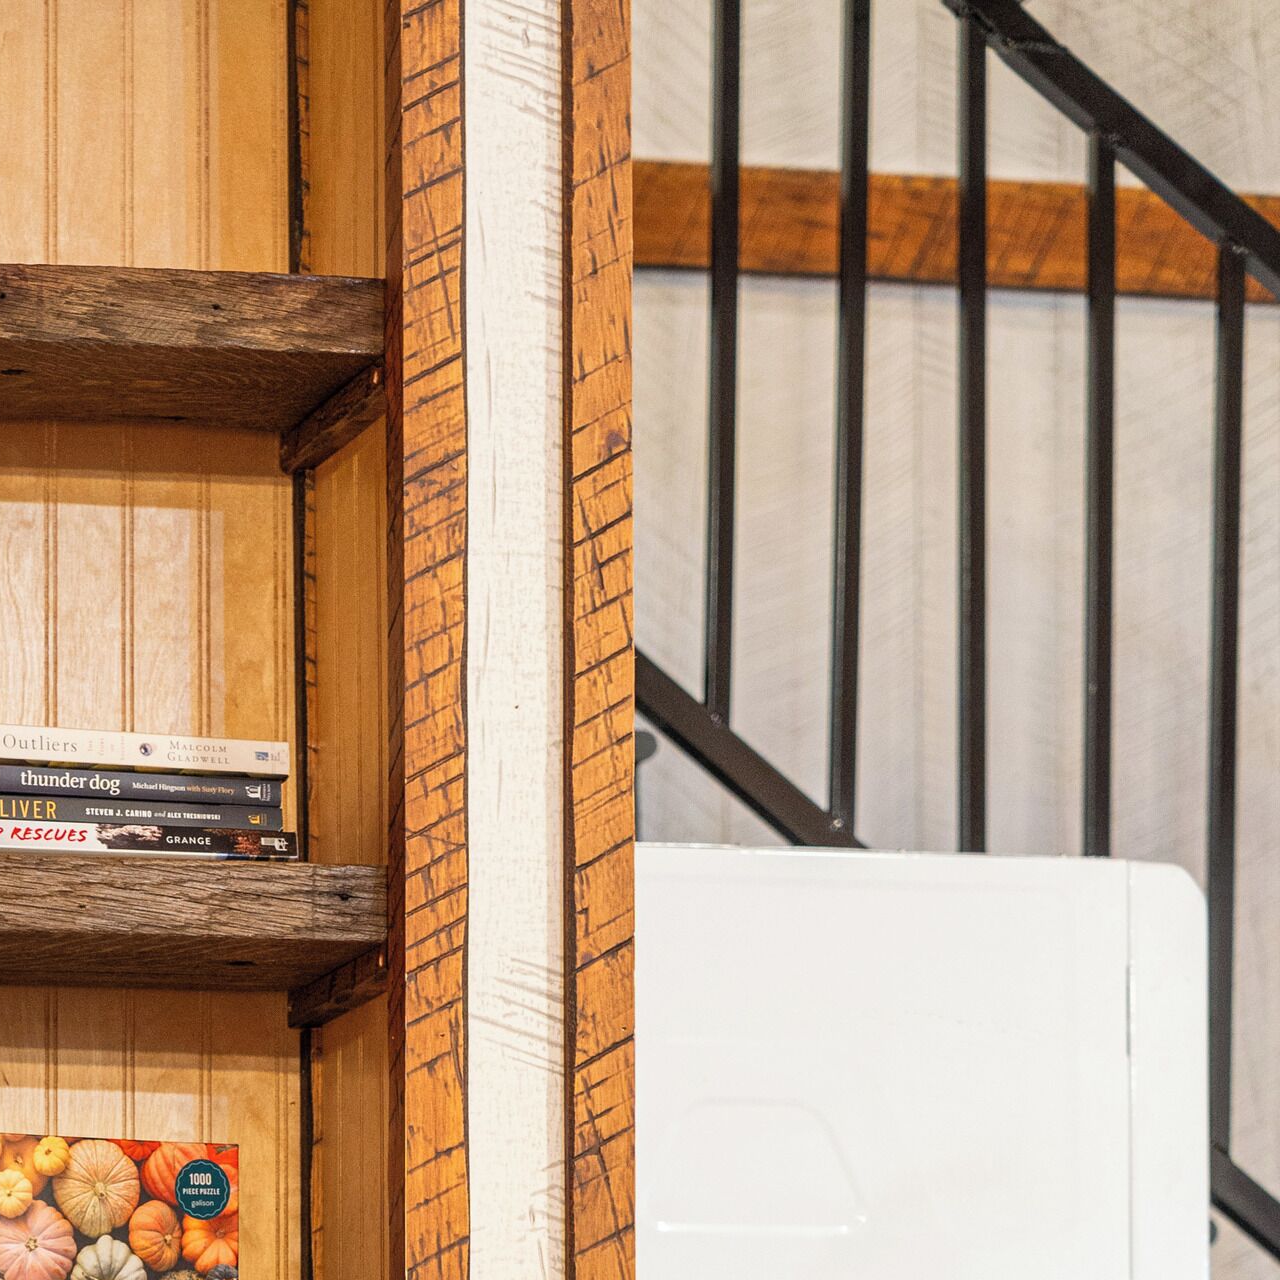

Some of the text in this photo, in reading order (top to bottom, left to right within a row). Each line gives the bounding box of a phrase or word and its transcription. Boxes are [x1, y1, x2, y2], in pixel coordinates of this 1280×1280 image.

[2, 733, 78, 753] Outliers
[169, 740, 227, 753] MALCOLM
[167, 751, 231, 765] GLADWELL
[20, 770, 121, 796] thunder dog
[132, 781, 158, 791] Michael
[158, 783, 186, 793] Hingson
[186, 784, 200, 793] with
[85, 807, 115, 817] STEVEN
[116, 808, 123, 818] J.
[125, 809, 152, 818] CARINO
[154, 810, 166, 819] and
[167, 812, 182, 820] ALEX
[10, 826, 88, 843] RESCUES
[166, 835, 212, 846] GRANGE
[189, 1173, 212, 1185] 1000
[191, 1199, 214, 1208] galison
